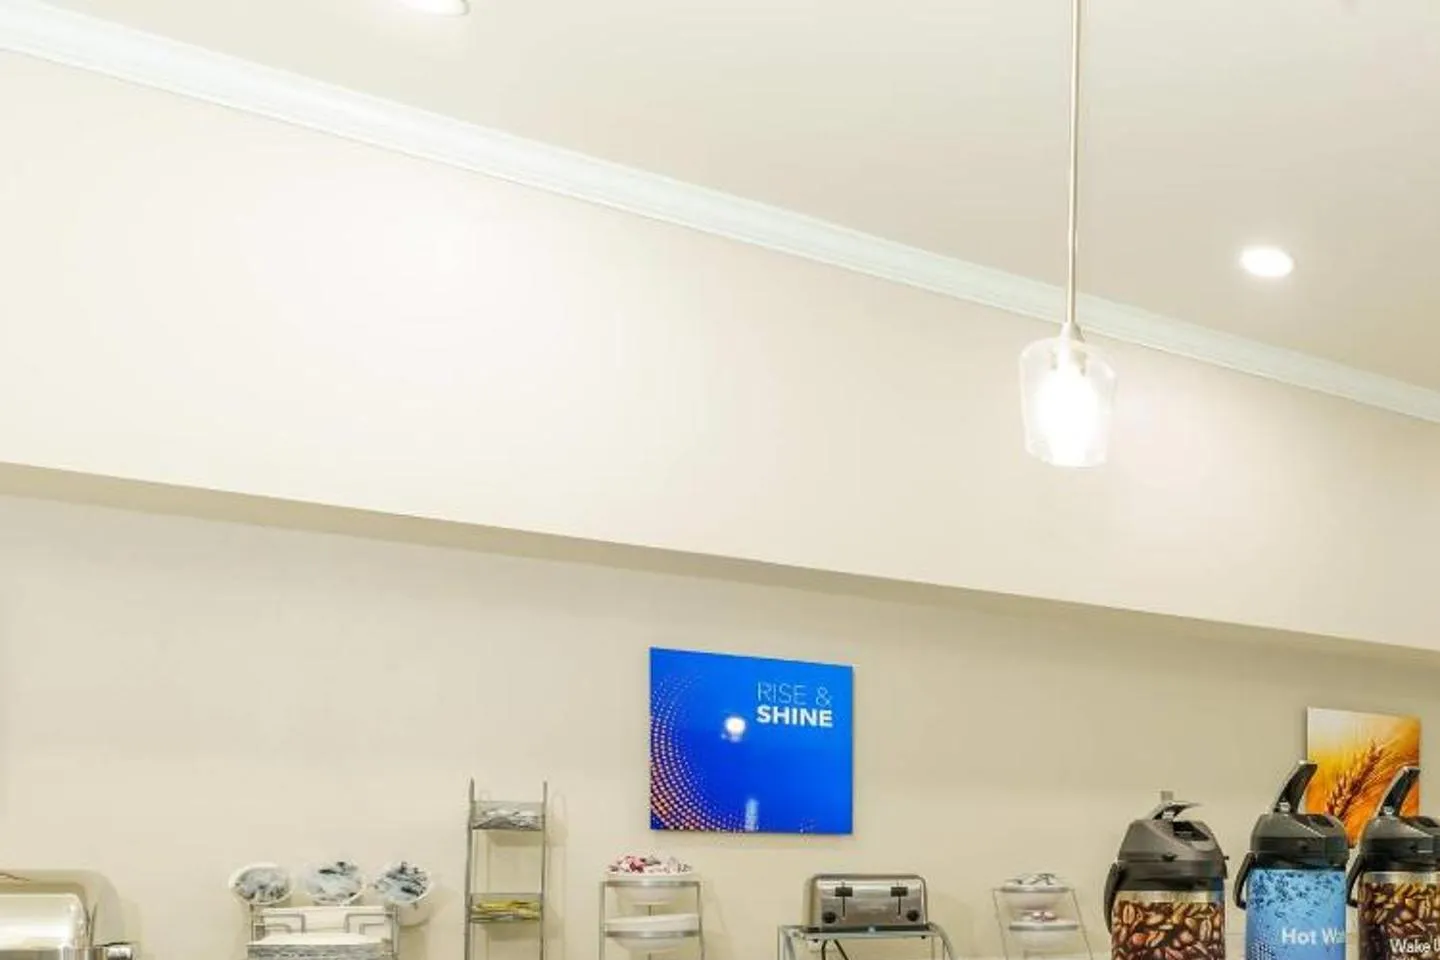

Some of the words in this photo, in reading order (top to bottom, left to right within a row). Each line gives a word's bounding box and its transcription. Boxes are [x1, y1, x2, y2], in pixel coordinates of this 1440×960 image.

[757, 681, 806, 705] RISE
[815, 686, 832, 708] &
[756, 704, 833, 728] SHINE
[1282, 927, 1317, 945] Hot
[1389, 938, 1431, 954] Wake
